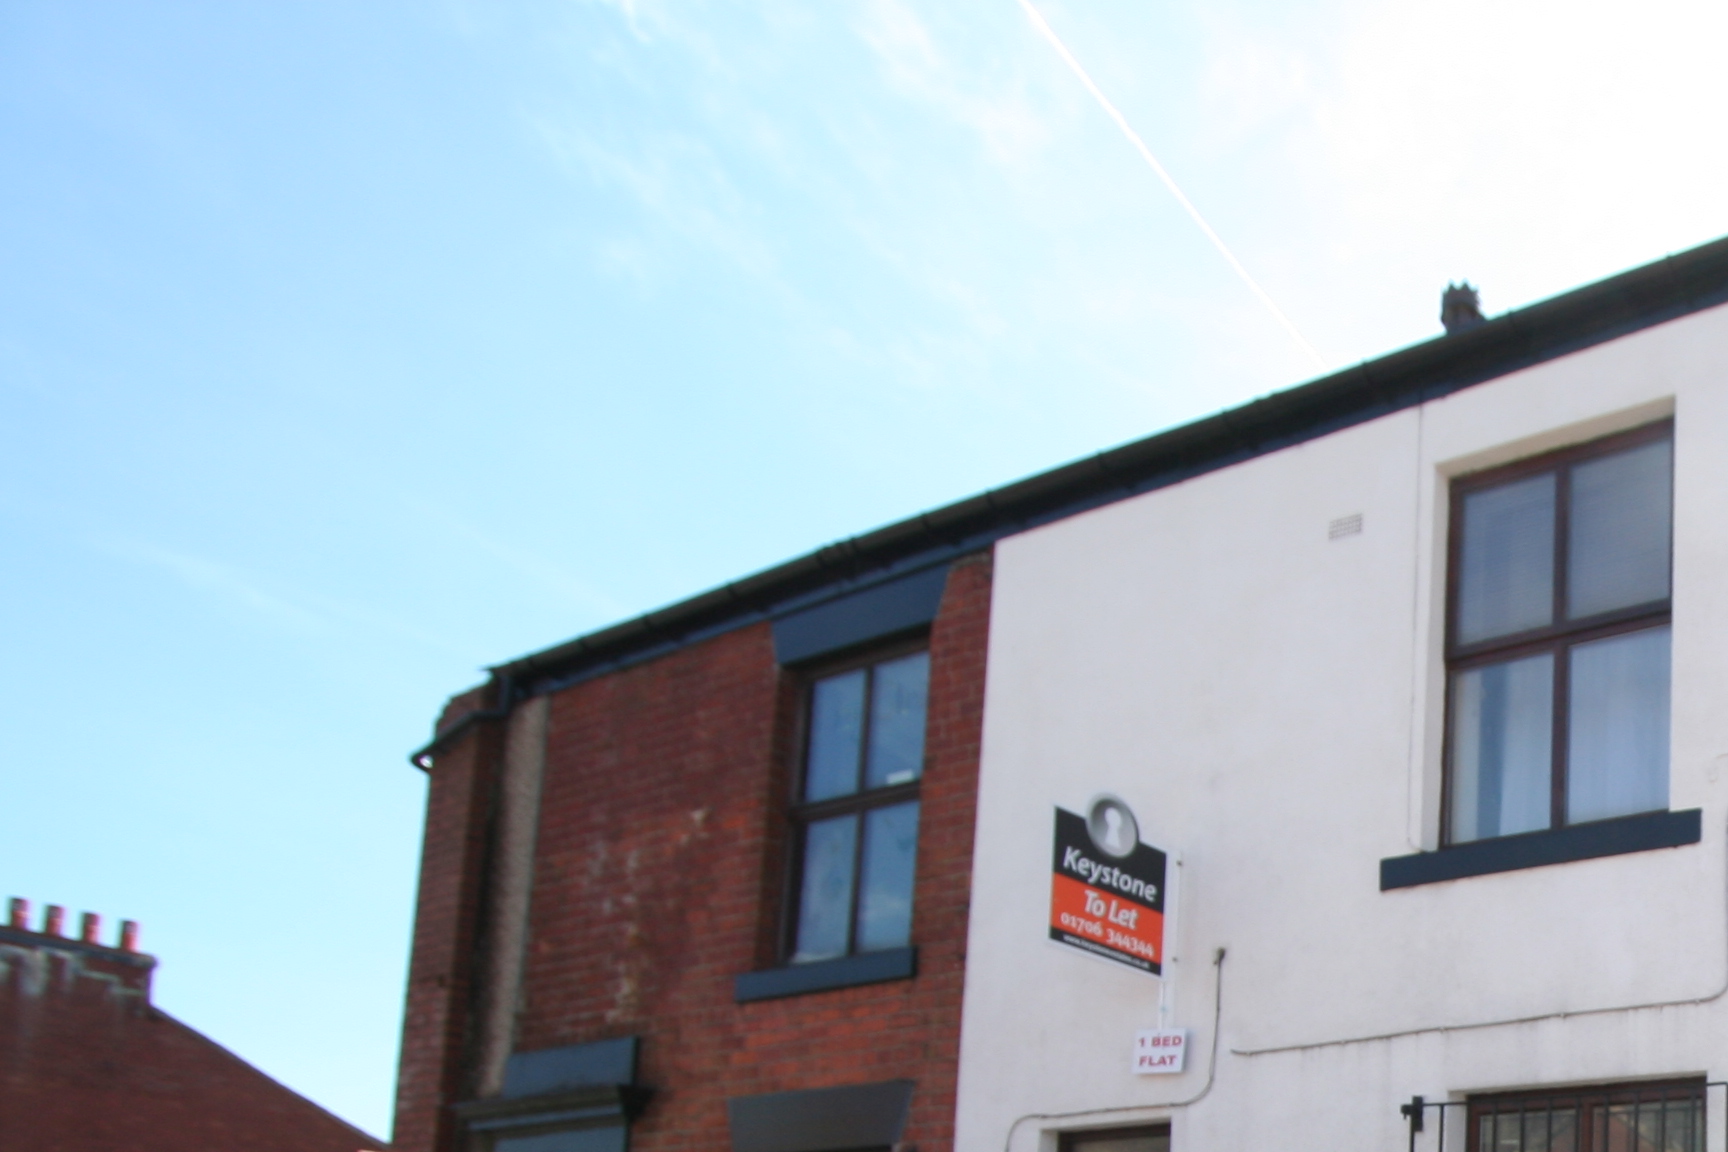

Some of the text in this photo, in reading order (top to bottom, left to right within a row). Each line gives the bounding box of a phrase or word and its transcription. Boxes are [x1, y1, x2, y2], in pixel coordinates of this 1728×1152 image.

[1063, 845, 1157, 902] Keystone
[1084, 889, 1139, 930] To Let
[1060, 911, 1155, 958] 01706 344344
[1138, 1055, 1177, 1067] FLAT
[1139, 1035, 1182, 1048] 1 BED
